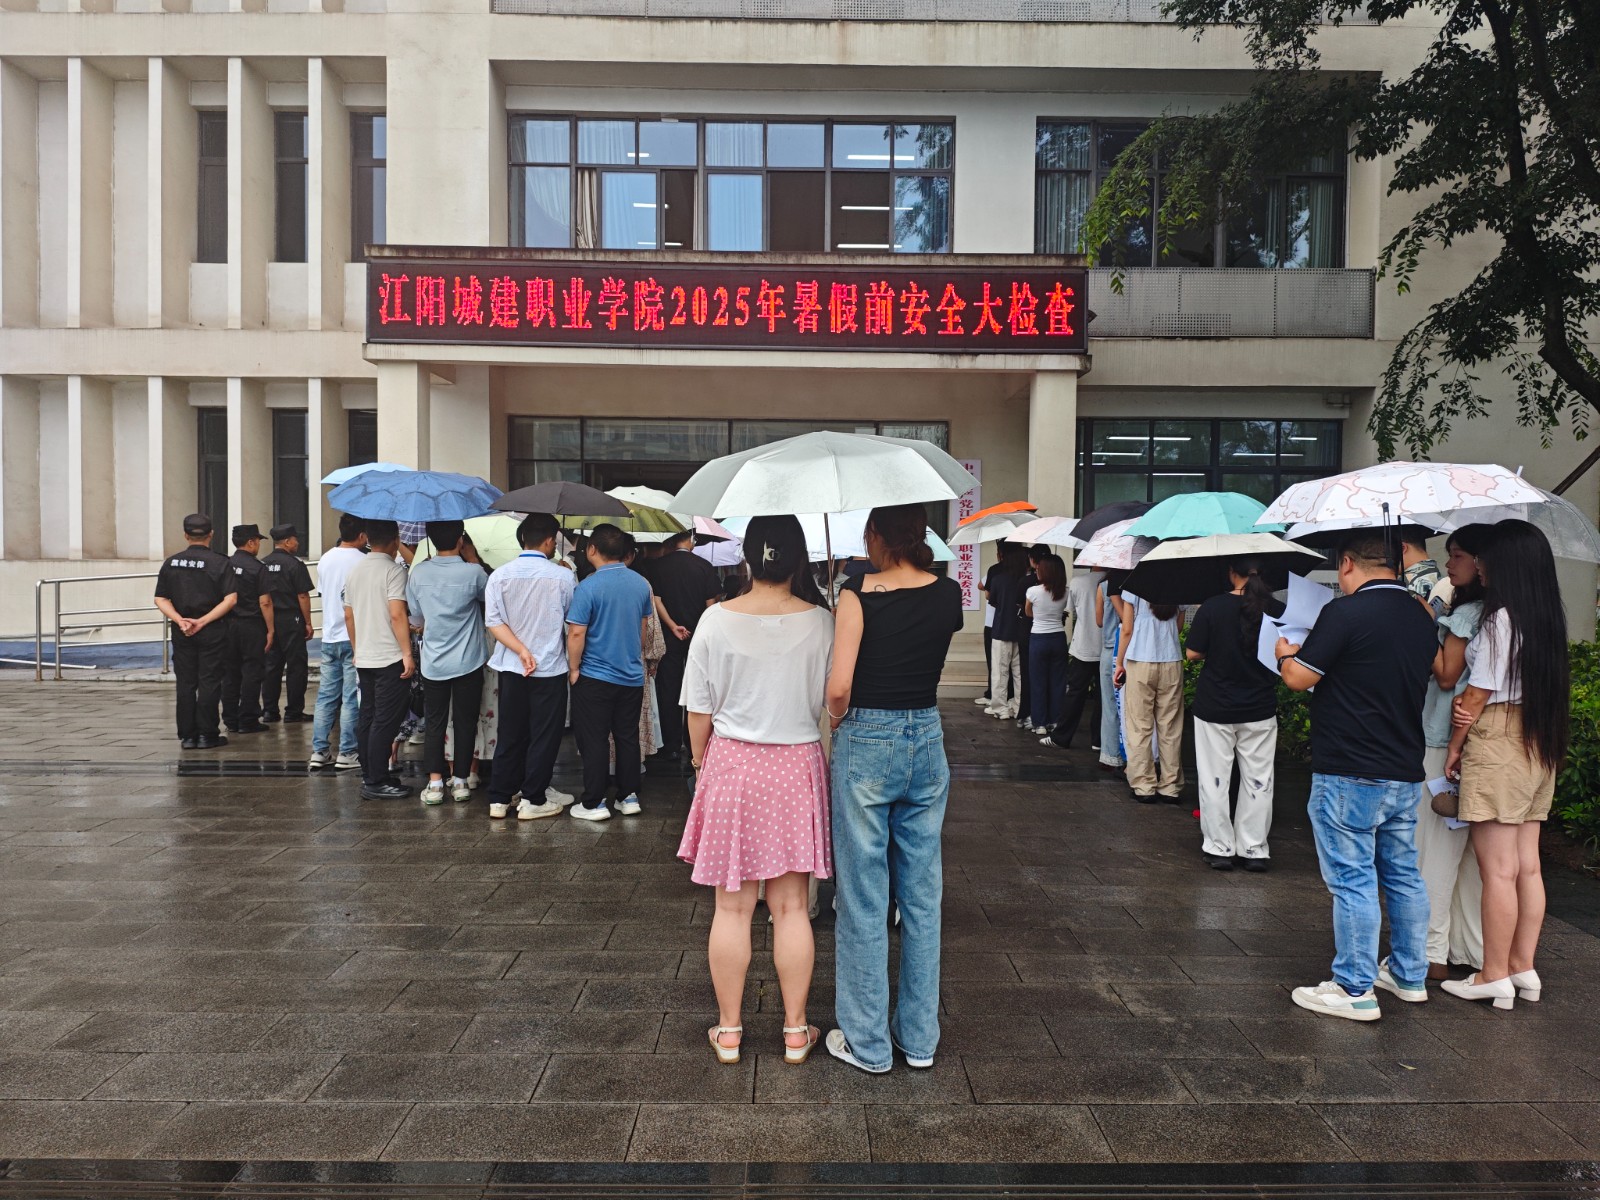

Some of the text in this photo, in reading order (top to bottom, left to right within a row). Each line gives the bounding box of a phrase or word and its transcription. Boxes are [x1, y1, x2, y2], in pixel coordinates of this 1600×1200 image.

[378, 272, 1075, 336] 江阳城建职业学院2025年暑假前安全大检查
